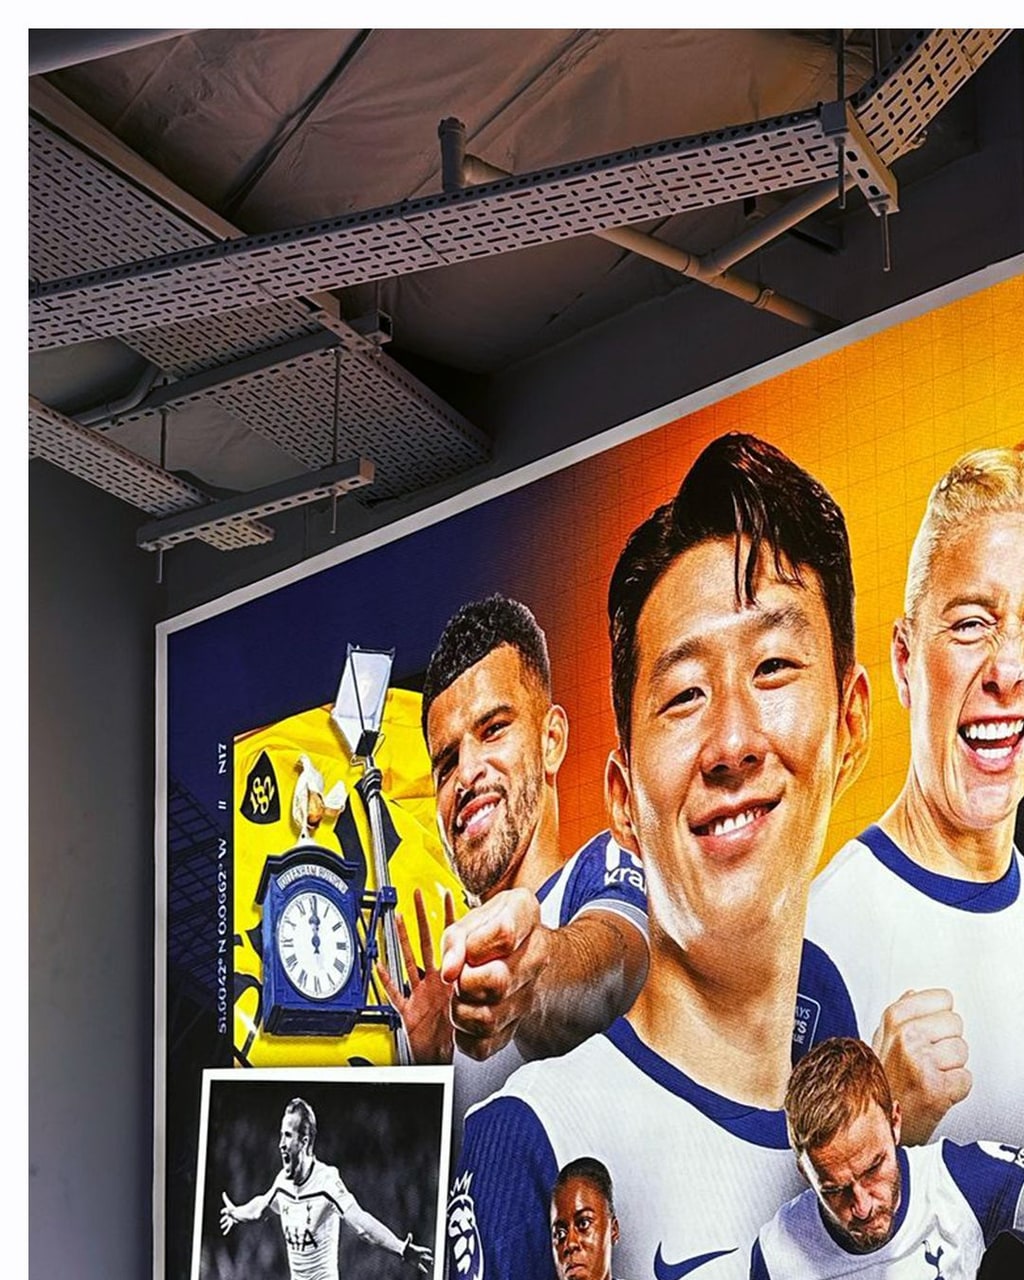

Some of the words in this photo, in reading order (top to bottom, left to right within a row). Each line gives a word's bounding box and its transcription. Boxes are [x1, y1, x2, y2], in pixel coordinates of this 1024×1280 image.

[217, 742, 228, 775] N17
[217, 837, 228, 860] W
[217, 939, 228, 953] N
